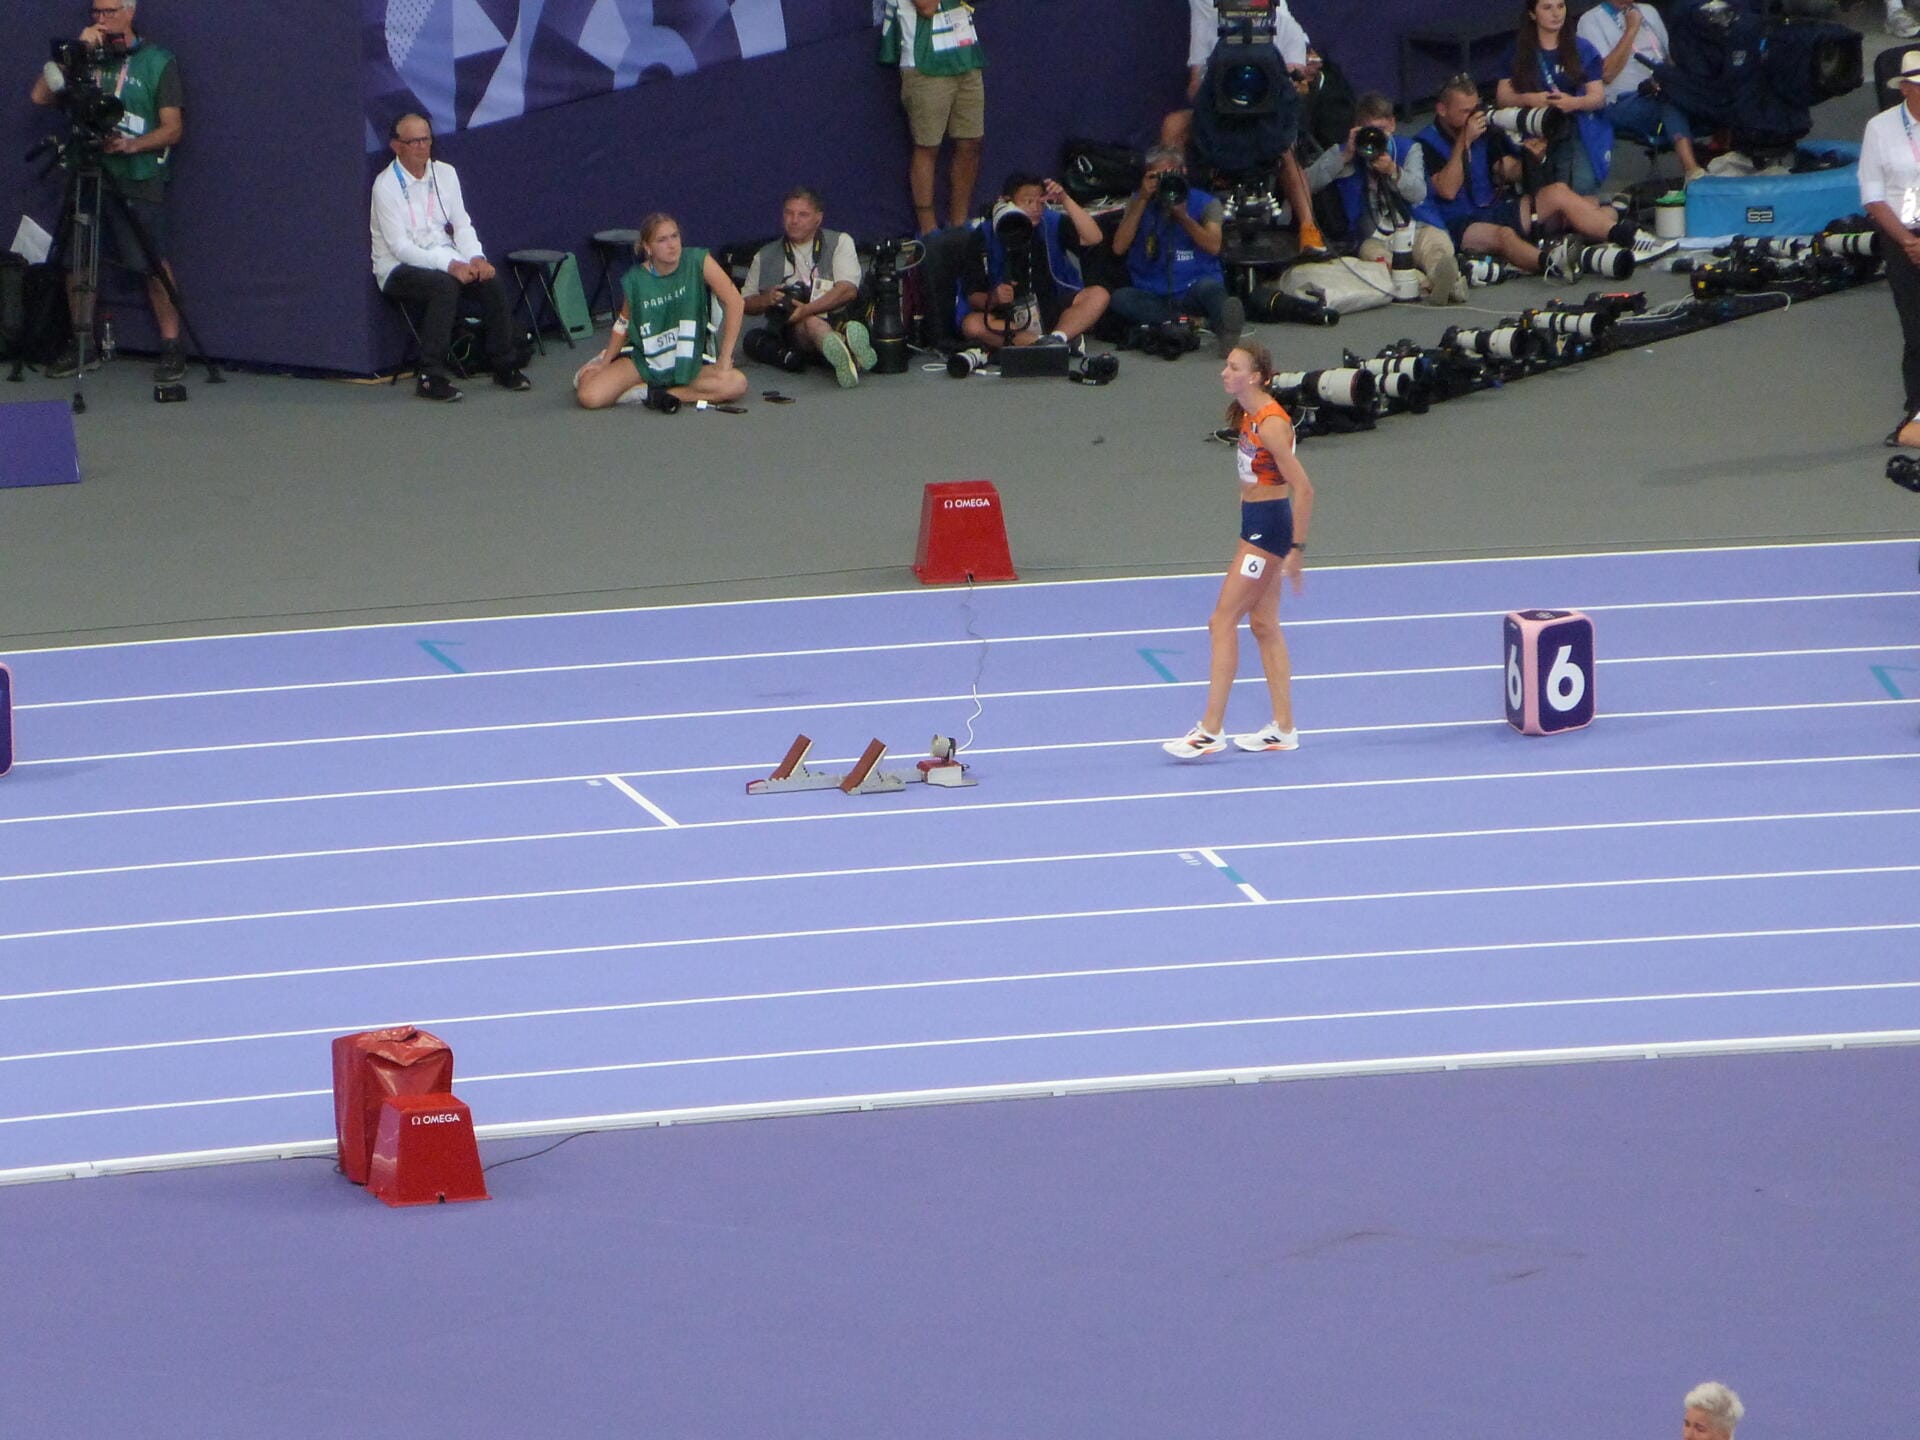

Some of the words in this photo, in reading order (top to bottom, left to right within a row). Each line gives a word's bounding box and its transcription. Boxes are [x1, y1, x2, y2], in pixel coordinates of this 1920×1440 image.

[954, 498, 990, 508] OMEGA
[1248, 560, 1258, 573] 6
[1508, 644, 1522, 711] 6
[1546, 645, 1585, 712] 6
[422, 1113, 461, 1125] OMEGA
